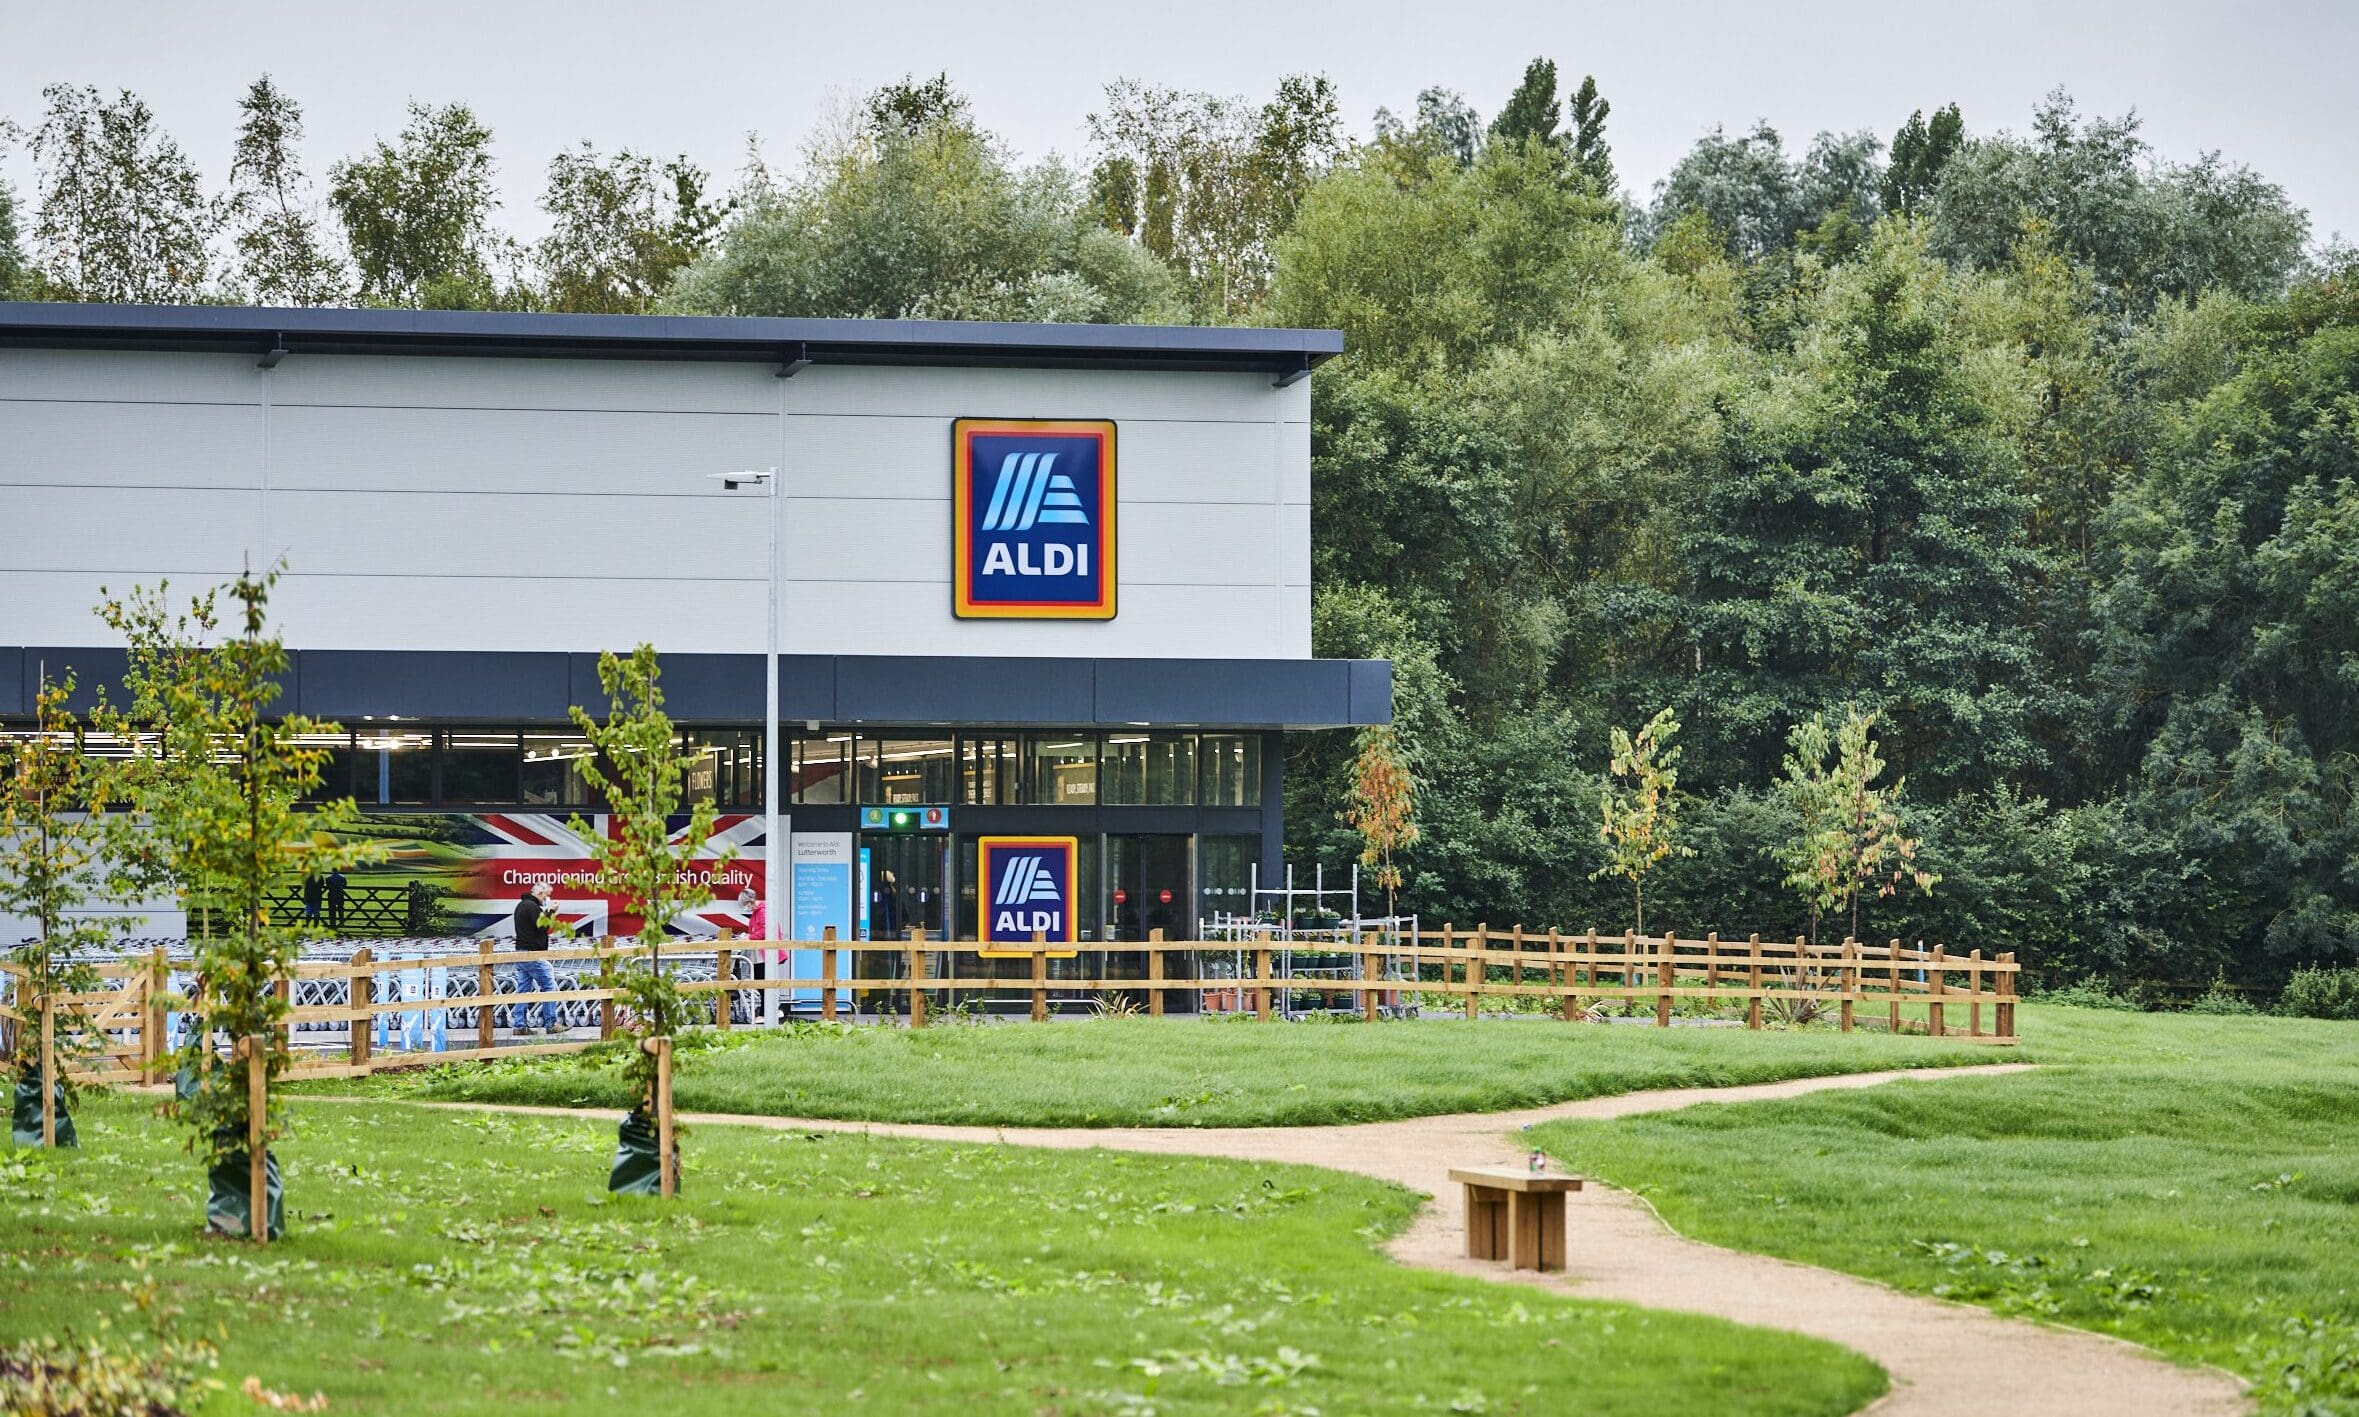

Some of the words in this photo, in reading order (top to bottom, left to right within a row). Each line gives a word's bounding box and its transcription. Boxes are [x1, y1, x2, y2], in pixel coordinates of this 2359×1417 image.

[982, 543, 1088, 576] ALDI
[700, 869, 753, 889] Quality
[995, 911, 1060, 932] ALDI
